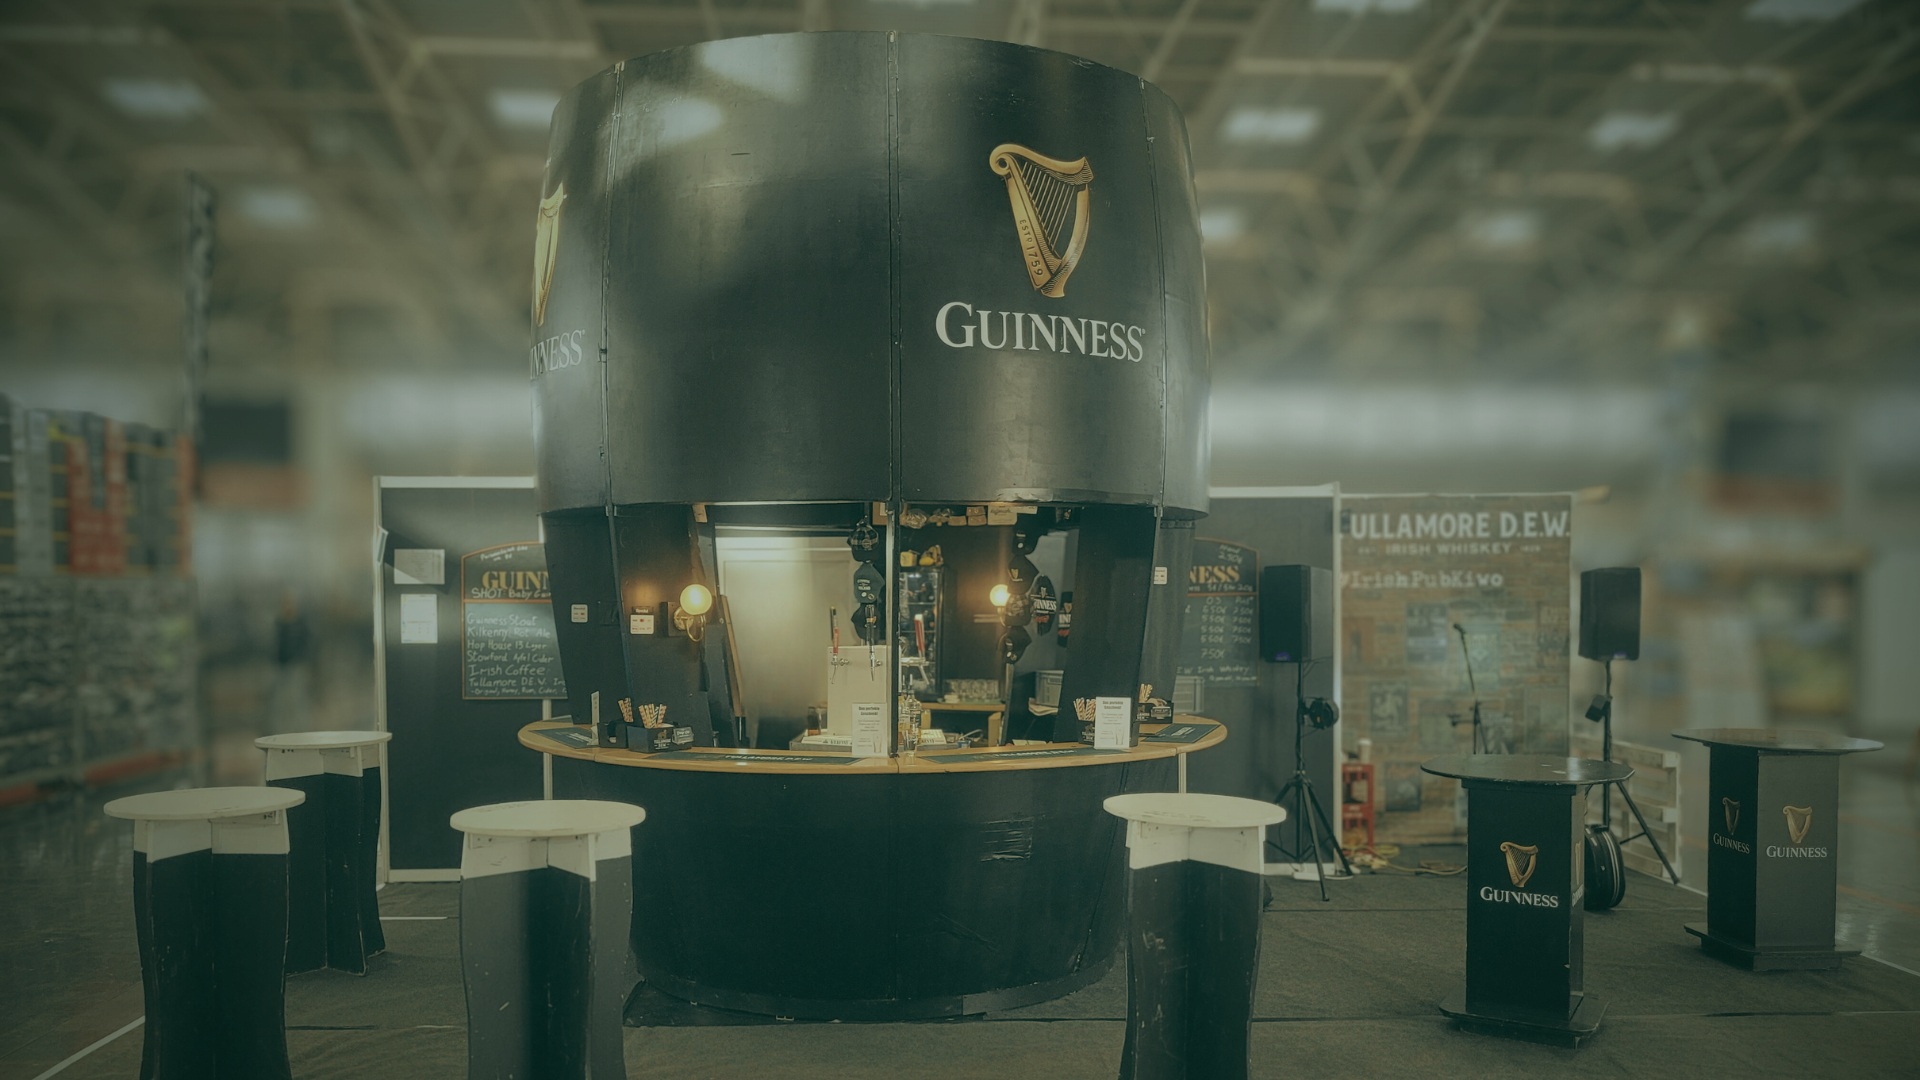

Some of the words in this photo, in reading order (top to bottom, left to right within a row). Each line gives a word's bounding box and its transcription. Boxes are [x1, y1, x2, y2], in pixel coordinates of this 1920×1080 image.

[1026, 246, 1044, 276] 1759
[935, 301, 1143, 363] GUINNESS
[1350, 512, 1490, 540] ULLAMORE
[1385, 543, 1431, 556] IRISH
[1436, 542, 1512, 555] WHISKEY
[467, 640, 486, 652] Hop
[488, 640, 513, 651] House
[469, 664, 503, 677] Irish
[505, 664, 547, 676] Coffee
[469, 677, 518, 688] Tullamore
[1713, 833, 1750, 855] GUINNESS
[1766, 845, 1828, 858] GUINNESS
[1480, 886, 1559, 908] GUINNESS
